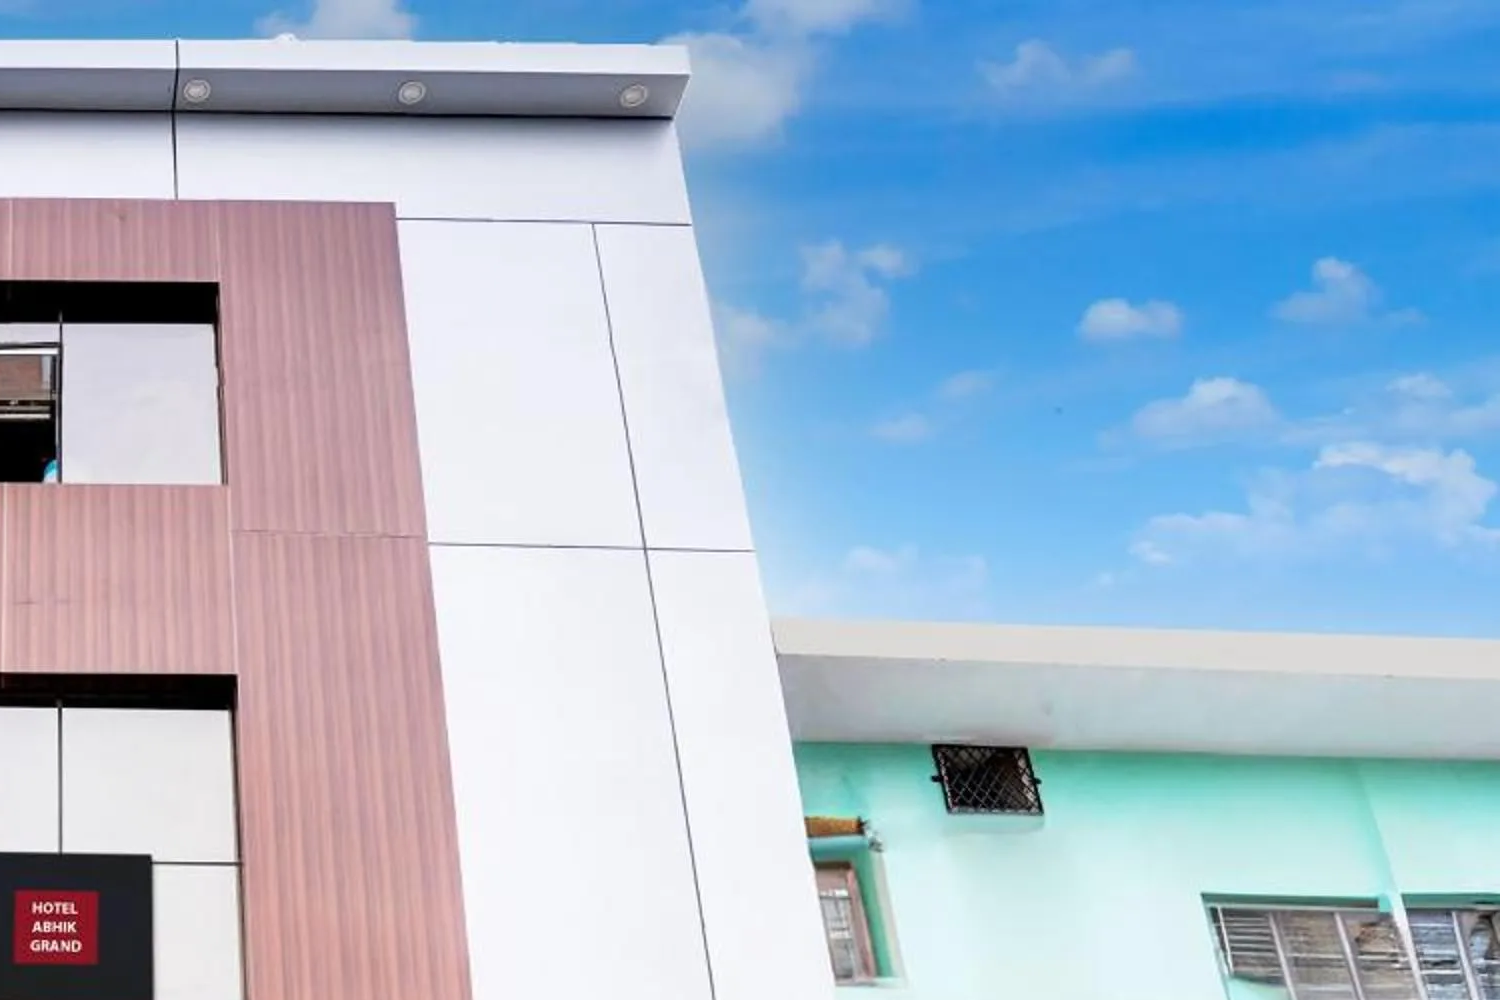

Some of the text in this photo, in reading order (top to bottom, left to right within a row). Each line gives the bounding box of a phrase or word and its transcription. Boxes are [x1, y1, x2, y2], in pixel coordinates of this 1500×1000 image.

[31, 901, 78, 915] HOTEL
[31, 920, 77, 934] ABHIK
[29, 938, 82, 953] GRAND
